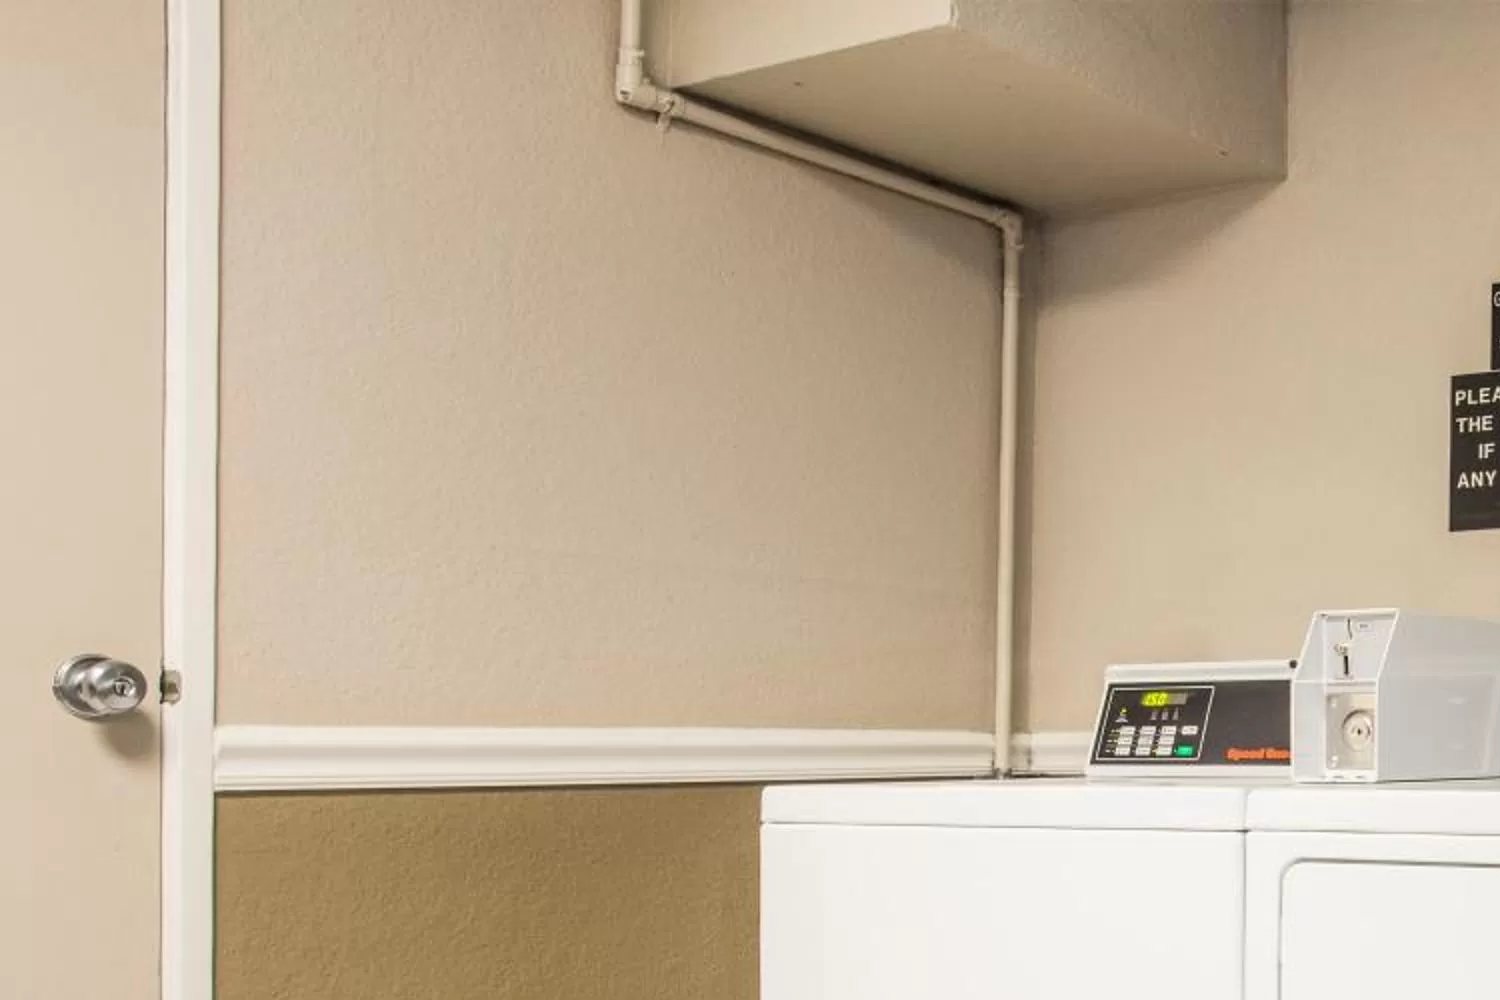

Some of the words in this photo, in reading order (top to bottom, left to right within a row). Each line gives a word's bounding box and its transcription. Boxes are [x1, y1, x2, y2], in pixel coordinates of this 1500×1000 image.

[1456, 415, 1493, 433] THE
[1478, 443, 1496, 459] IF
[1457, 470, 1497, 488] ANY
